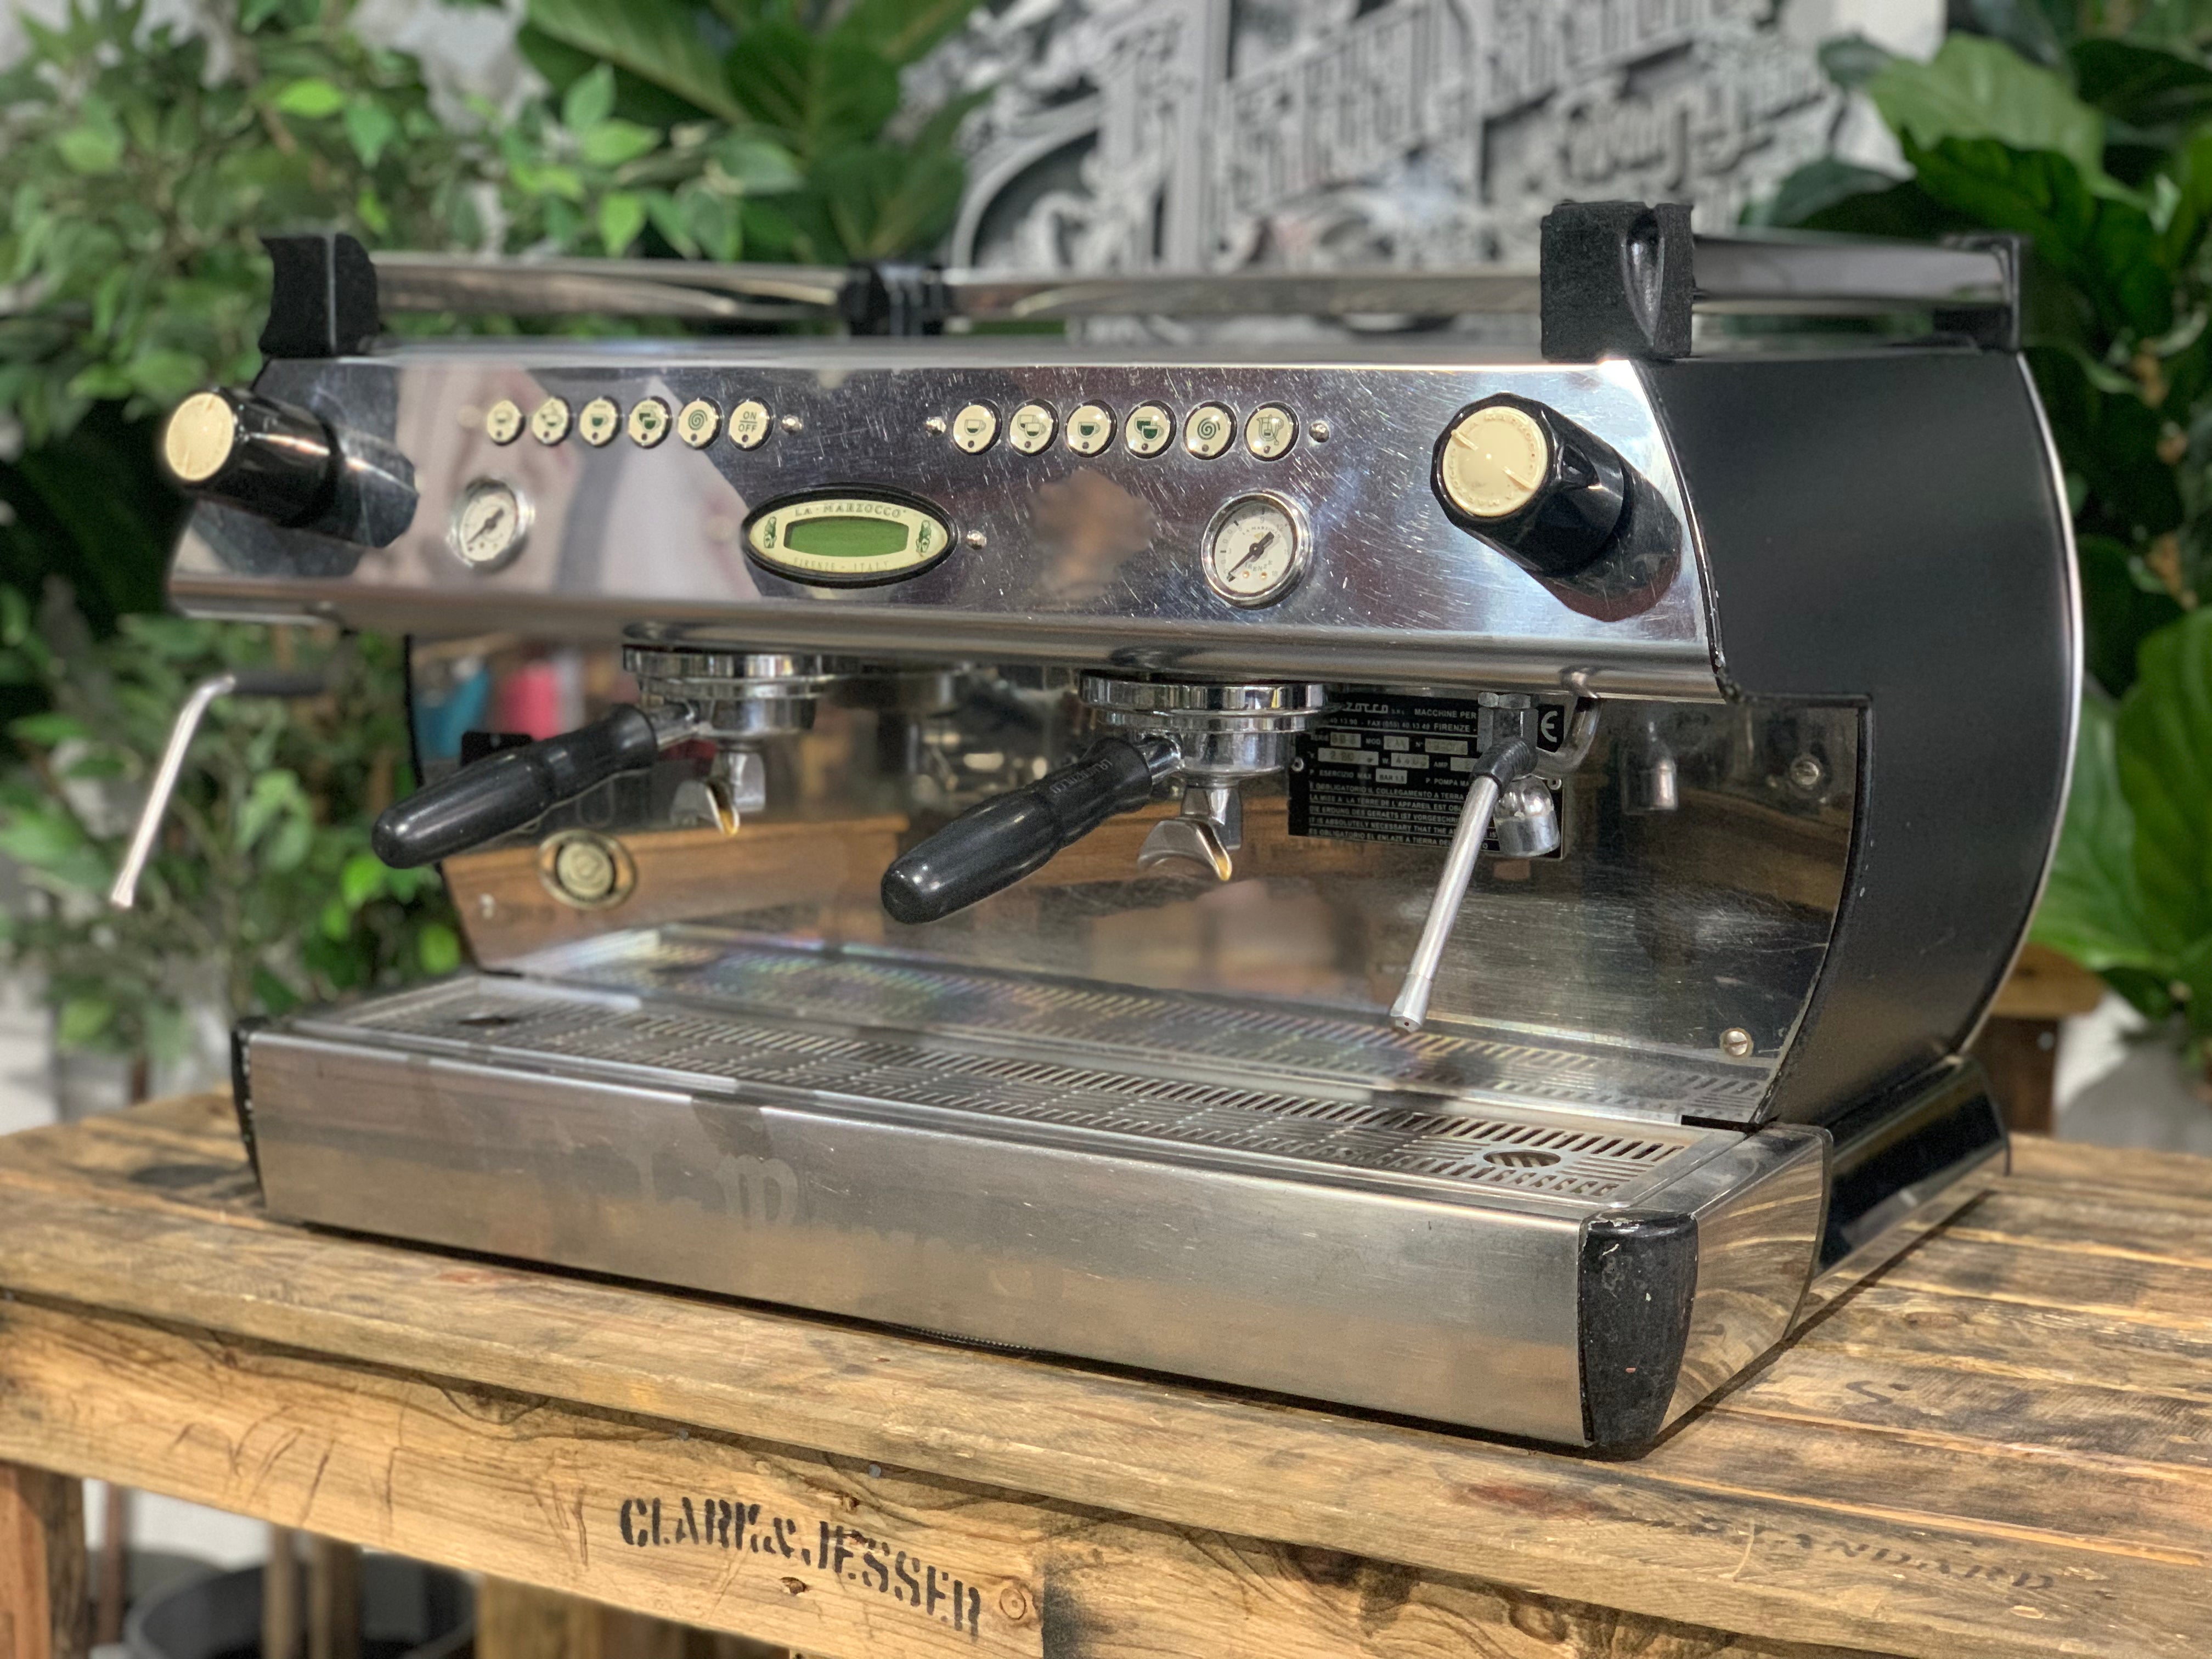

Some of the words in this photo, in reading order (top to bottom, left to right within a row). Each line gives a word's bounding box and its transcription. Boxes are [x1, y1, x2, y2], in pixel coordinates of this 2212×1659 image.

[743, 411, 758, 420] ON
[738, 423, 757, 432] OFF
[794, 506, 812, 517] LA
[823, 503, 903, 518] MARZOCCO
[793, 557, 836, 571] FIRENZE
[853, 560, 889, 573] ITALY
[1244, 560, 1273, 572] IRENZE
[1414, 708, 1458, 718] MACCHINE
[1460, 710, 1477, 719] PER
[1434, 723, 1471, 732] FIRENZE
[1319, 769, 1355, 778] ESERCIZIO
[1434, 778, 1458, 786] POMPA
[1316, 782, 1367, 793] OBBLIGATORIO
[1375, 787, 1432, 797] COLLEGAMENTO
[1322, 806, 1350, 815] ERDUNG
[1367, 810, 1399, 819] GERAETS
[1413, 813, 1458, 823] VORGESCHRI
[1325, 818, 1369, 828] ABSOLUTELY
[1370, 822, 1412, 832] NECESSARY
[1319, 828, 1365, 839] OBLIGATORIO
[1376, 834, 1403, 842] ENLAZE
